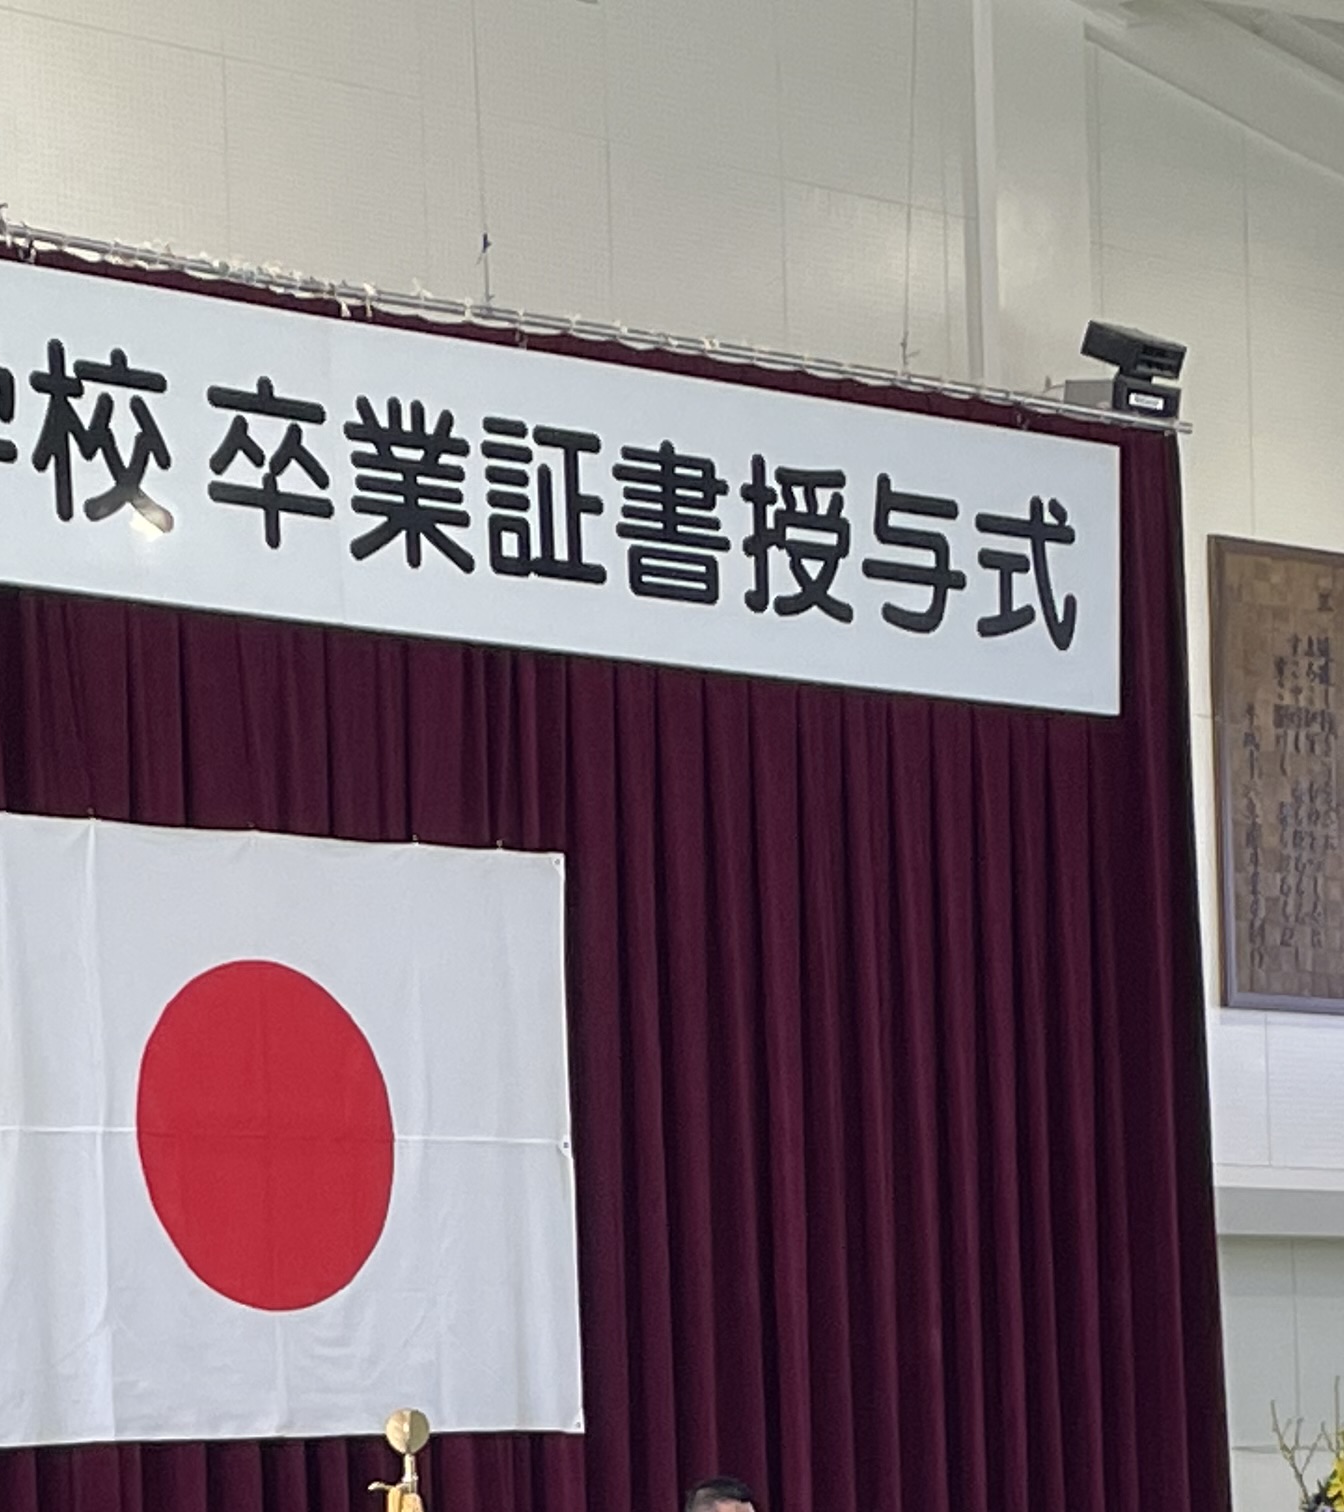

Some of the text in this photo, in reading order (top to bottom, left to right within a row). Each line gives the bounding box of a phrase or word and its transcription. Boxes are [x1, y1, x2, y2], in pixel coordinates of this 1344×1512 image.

[206, 375, 1078, 652] 卒業証書授与式
